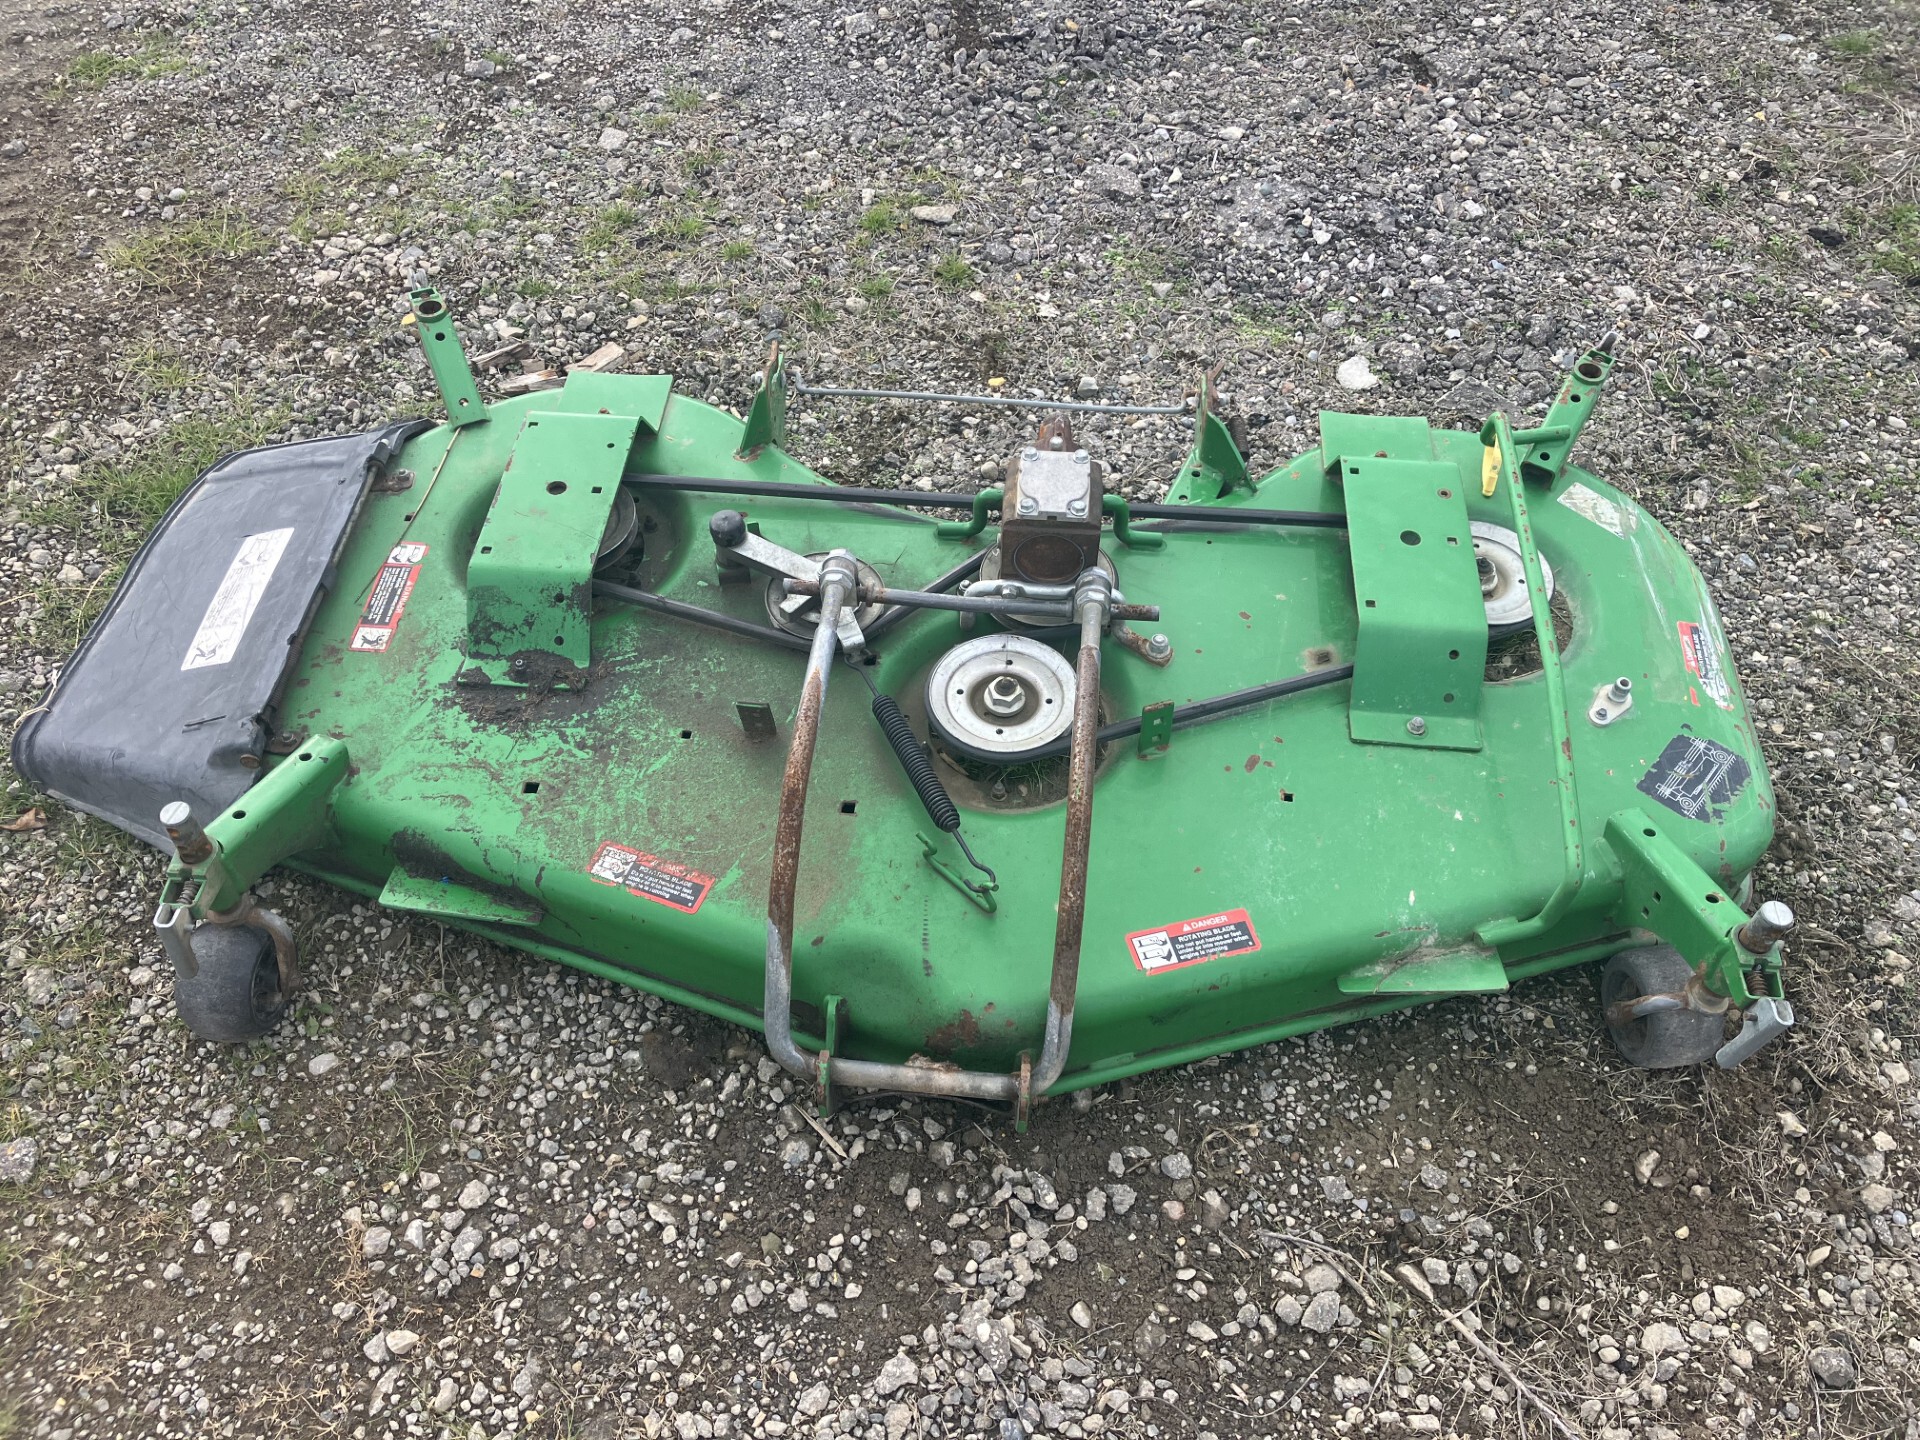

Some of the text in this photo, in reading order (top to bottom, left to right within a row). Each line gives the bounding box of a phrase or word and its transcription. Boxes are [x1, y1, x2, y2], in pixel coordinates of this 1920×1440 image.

[1191, 916, 1228, 929] DANGER
[1178, 925, 1236, 942] ROTATING BLADE
[1206, 945, 1228, 955] running
